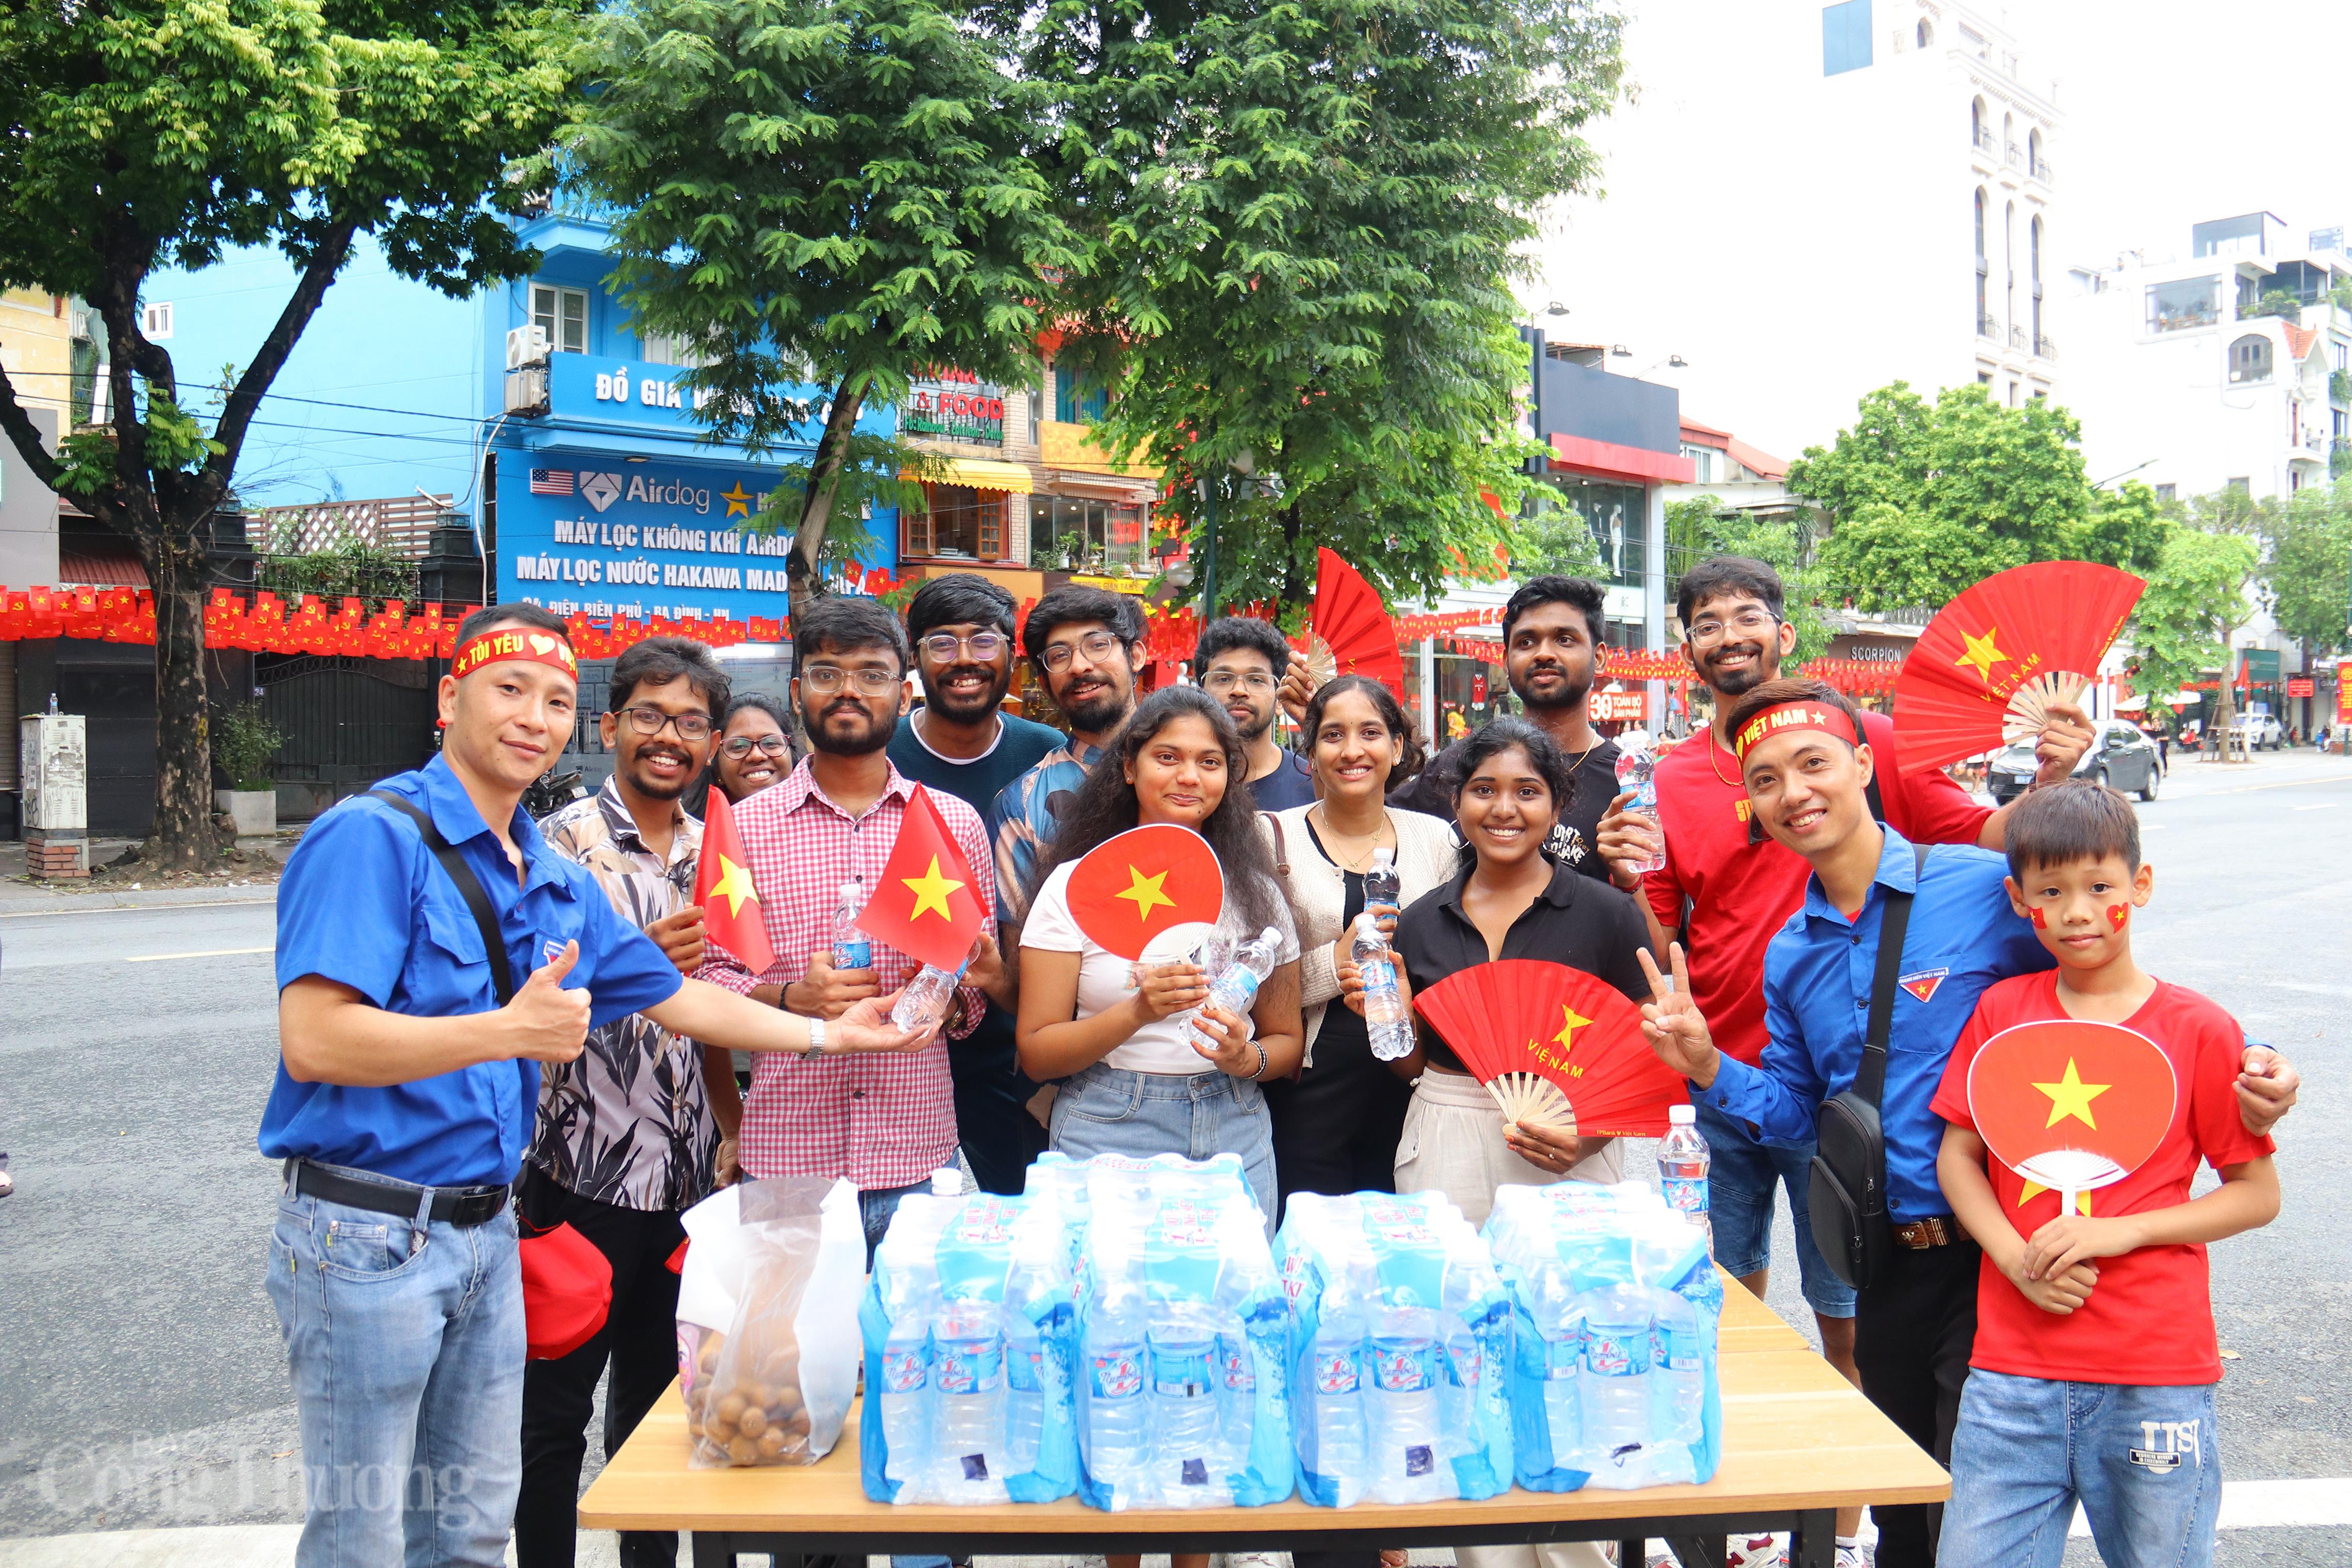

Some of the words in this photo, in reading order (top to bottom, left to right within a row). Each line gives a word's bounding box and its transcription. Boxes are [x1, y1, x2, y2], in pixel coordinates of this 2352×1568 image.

[596, 367, 629, 402] ĐỒ
[641, 380, 681, 409] GIA
[917, 391, 932, 409] &
[939, 392, 1004, 420] FOOD
[626, 475, 710, 515] Airdog
[554, 516, 599, 545] MÁY
[601, 524, 639, 552] LỌC
[642, 523, 706, 552] KHÔNG
[709, 528, 741, 554] KHÍ
[746, 534, 795, 558] AIRD
[517, 552, 561, 581] MÁY
[563, 558, 601, 587] LỌC
[606, 556, 660, 586] NƯỚC
[664, 565, 742, 590] HAKAWA
[746, 569, 789, 593] MAD
[549, 599, 579, 619] ĐIỆN
[584, 600, 613, 618] BIÊN
[617, 601, 642, 618] PHỦ
[673, 604, 702, 621] ĐÌNH
[493, 633, 524, 656] YÊU
[1980, 680, 2010, 703] VỆT
[2010, 652, 2041, 683] NAM
[1590, 694, 1612, 721] 30
[1612, 694, 1630, 707] TOÀN
[1613, 707, 1625, 718] SẢN
[1743, 716, 1768, 746] VIỆT
[1770, 709, 1808, 729] NAM
[1735, 798, 1754, 822] ST
[1527, 1038, 1550, 1064] VIỆ
[1548, 1056, 1584, 1079] NAM
